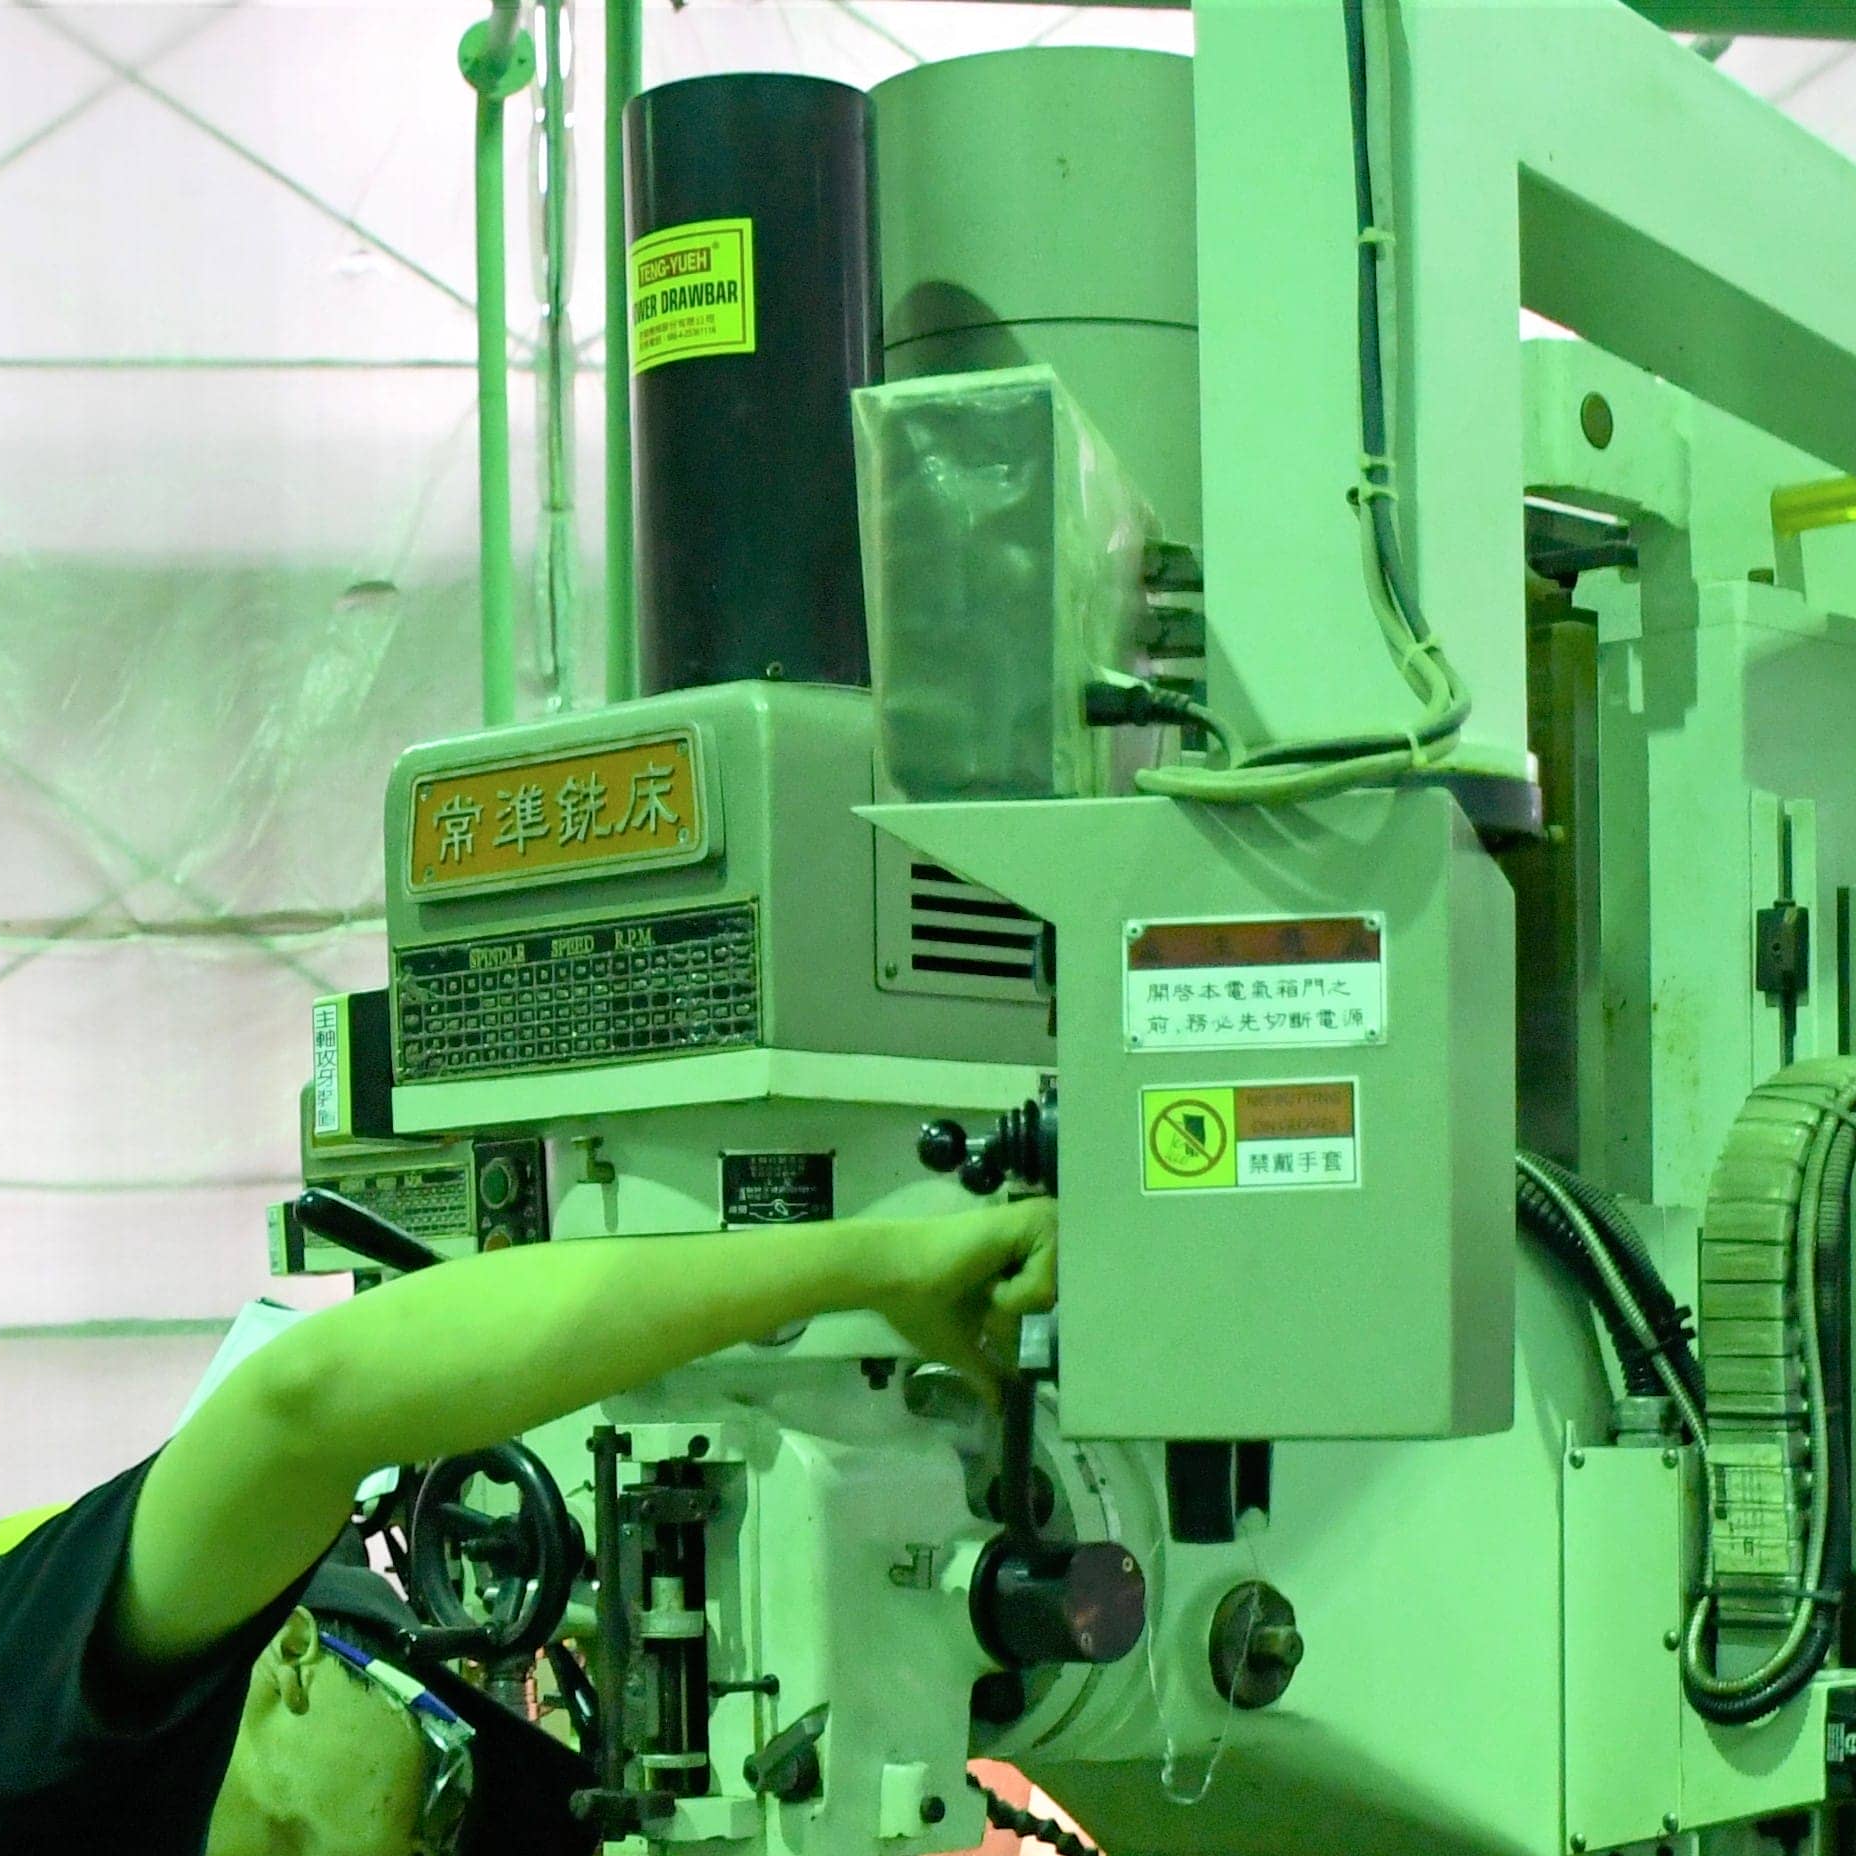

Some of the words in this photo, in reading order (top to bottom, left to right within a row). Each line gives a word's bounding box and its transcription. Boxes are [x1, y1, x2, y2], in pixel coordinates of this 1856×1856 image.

[639, 249, 708, 284] TENG-YUEH
[661, 279, 738, 314] DRAWBAR
[432, 760, 680, 864] 常準銑床
[469, 942, 526, 970] SPINDLE
[551, 935, 594, 958] SPEED
[1248, 1149, 1343, 1175] 禁戴手套
